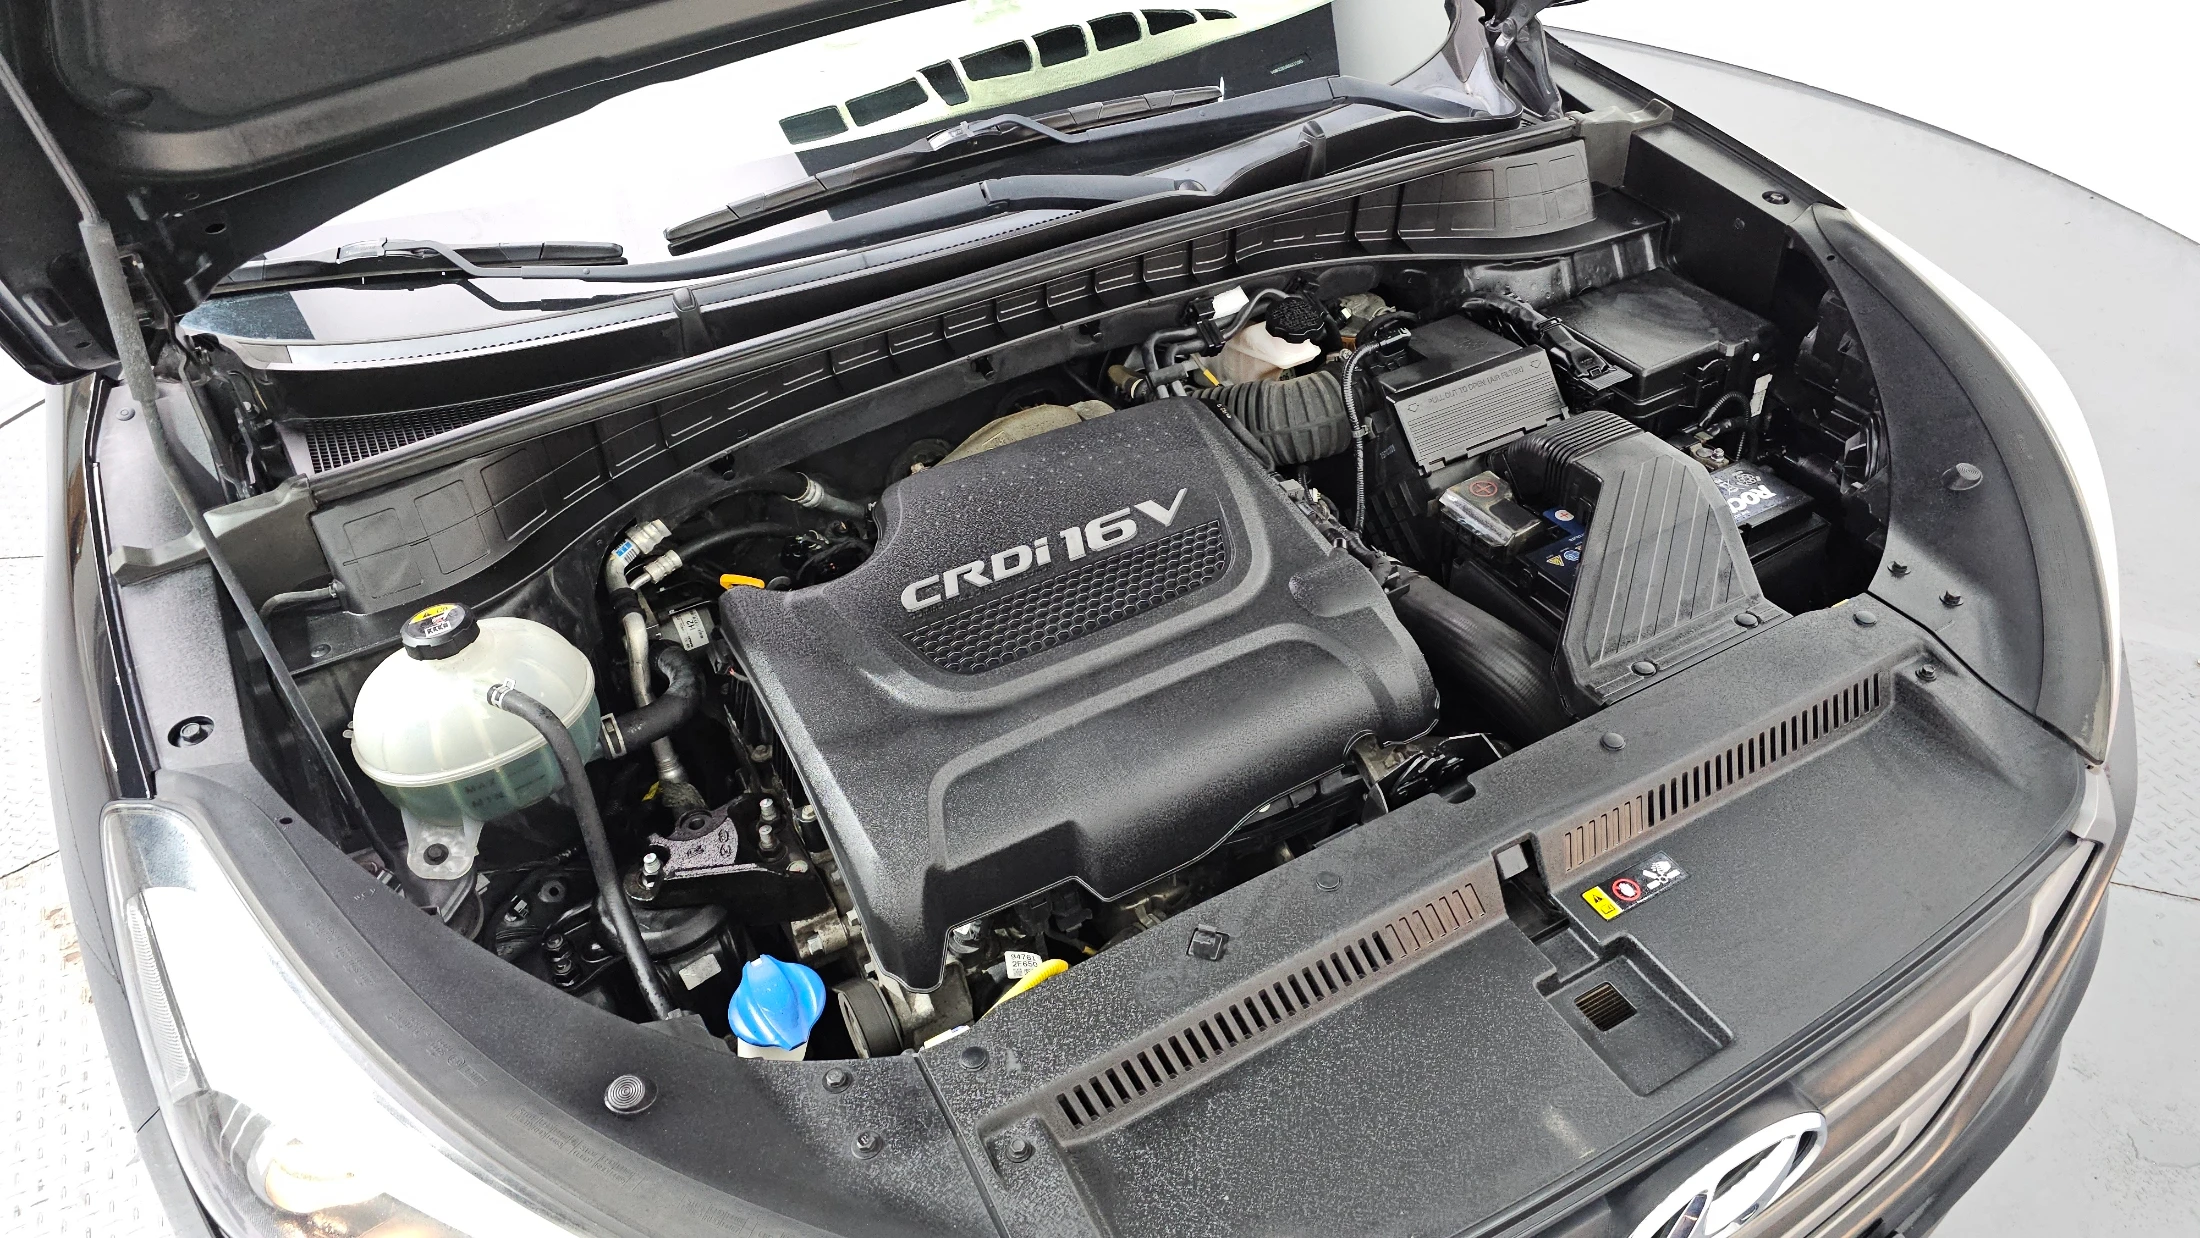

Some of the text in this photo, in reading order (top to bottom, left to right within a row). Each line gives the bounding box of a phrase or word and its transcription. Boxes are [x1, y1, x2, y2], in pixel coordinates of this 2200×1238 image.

[1428, 365, 1524, 405] PULL OUT TO OPEN (AIR FILTER)
[1728, 485, 1776, 514] ROC
[901, 488, 1187, 612] CRDi 16V
[465, 779, 495, 793] MAX
